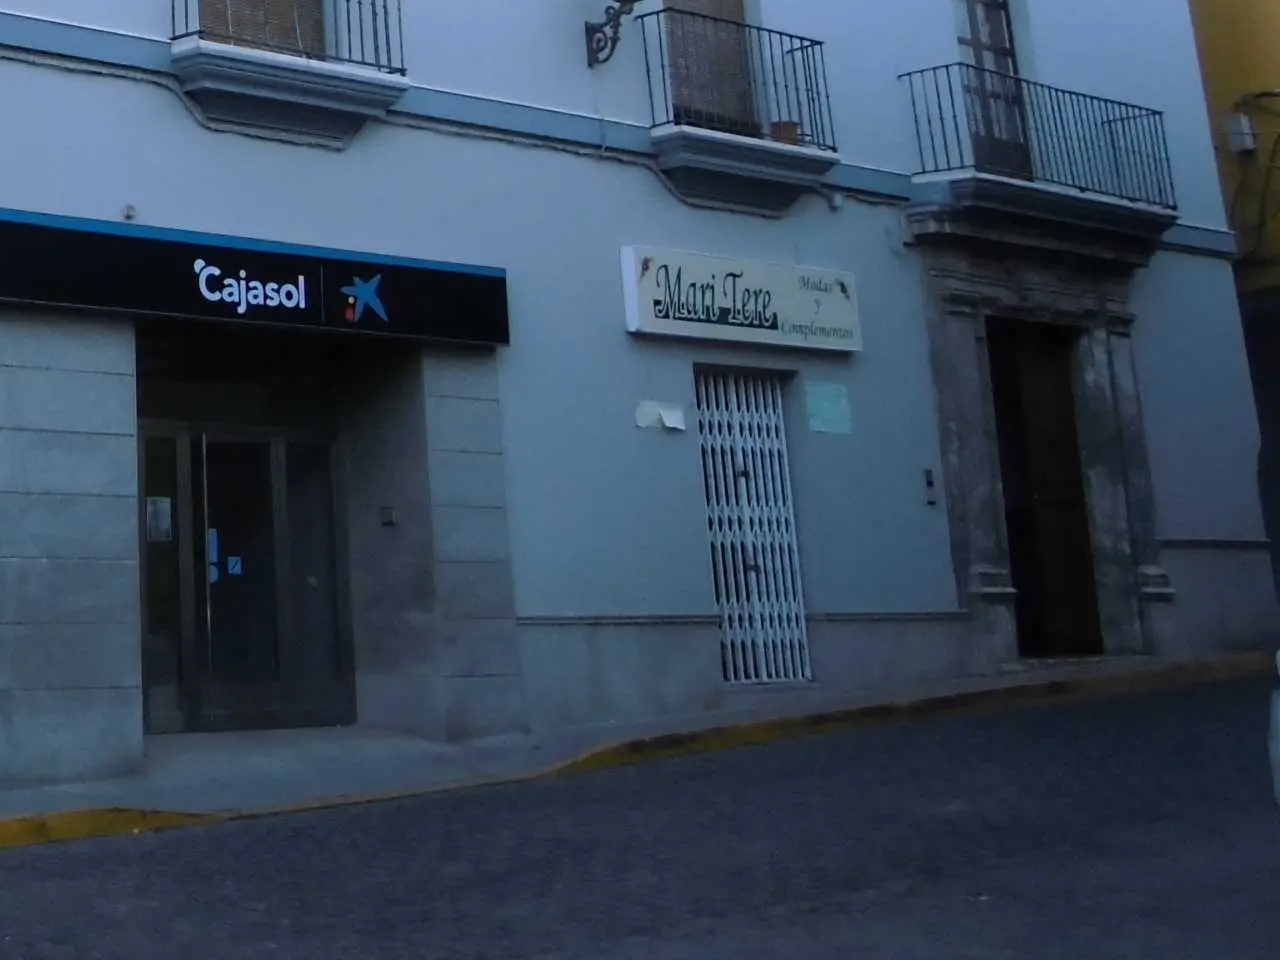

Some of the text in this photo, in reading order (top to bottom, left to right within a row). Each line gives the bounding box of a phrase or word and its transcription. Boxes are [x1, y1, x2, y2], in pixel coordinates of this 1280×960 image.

[193, 258, 306, 315] Cajasol
[655, 263, 778, 328] Mari Tere
